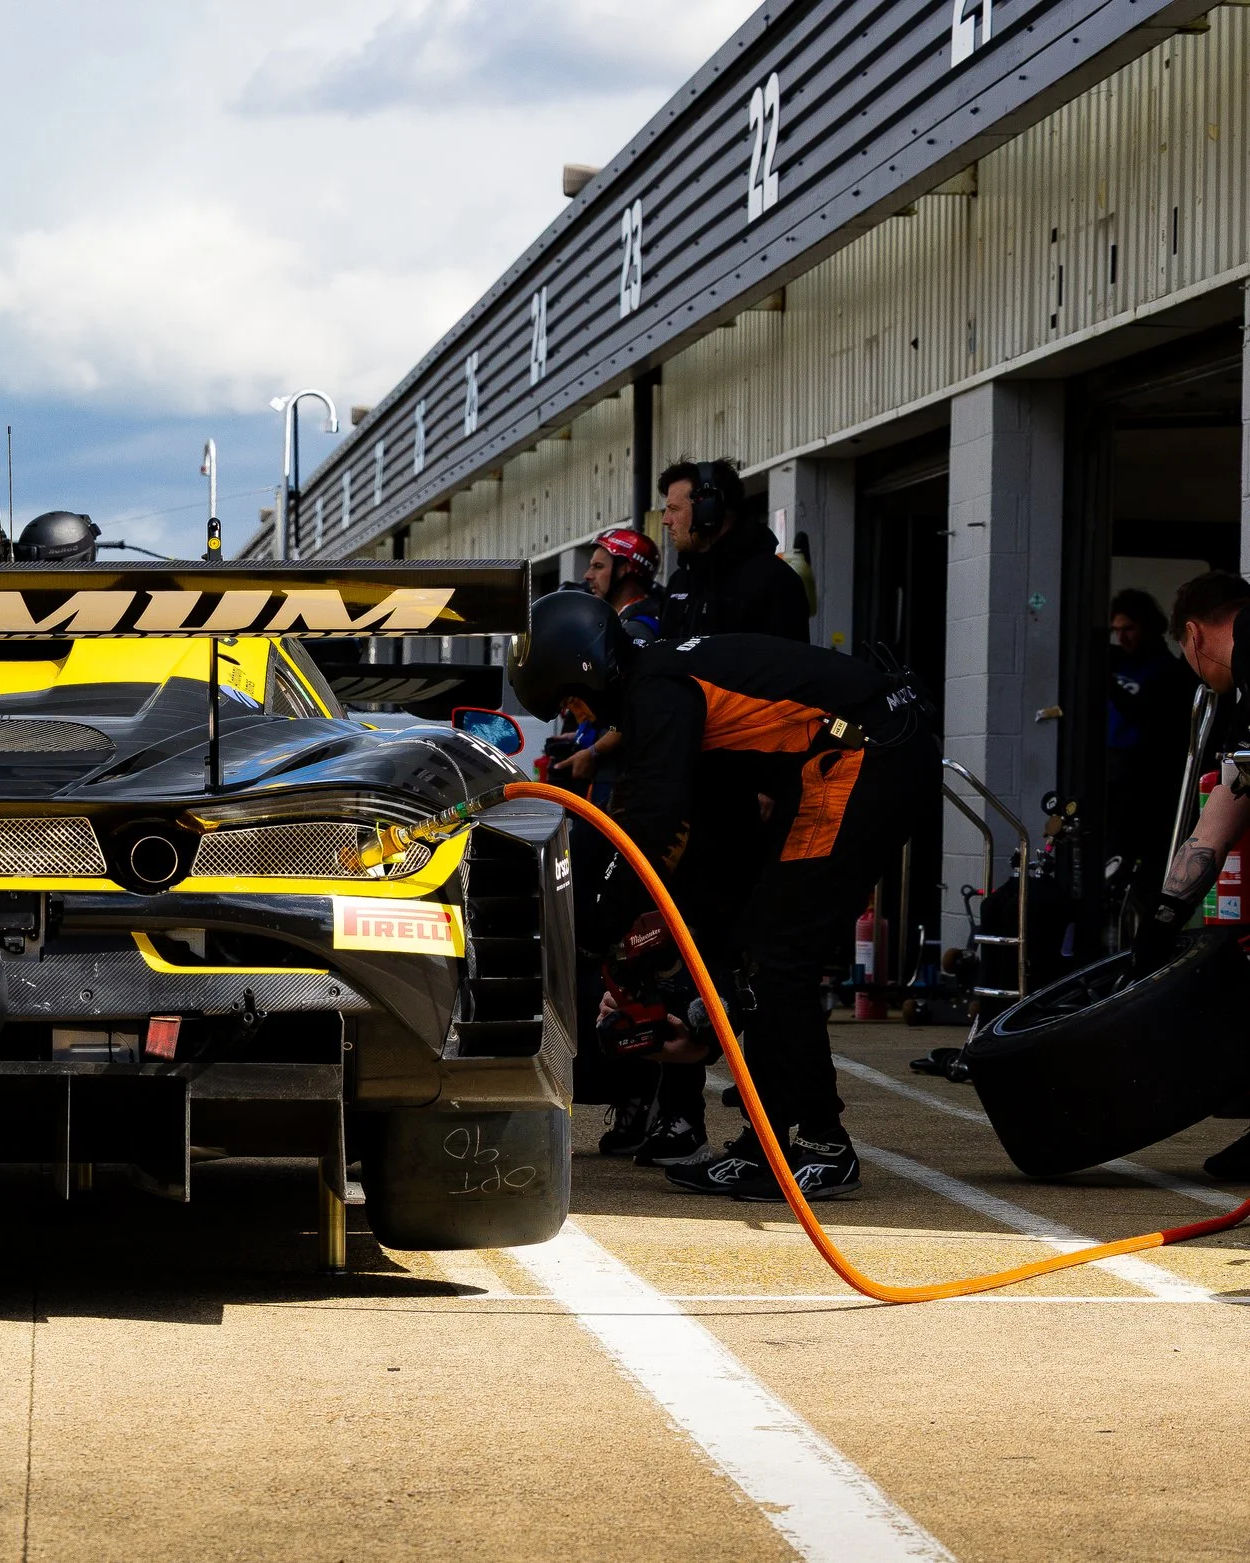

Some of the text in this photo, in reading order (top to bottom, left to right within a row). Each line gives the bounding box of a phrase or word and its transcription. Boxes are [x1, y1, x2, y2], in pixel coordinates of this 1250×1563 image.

[748, 72, 780, 224] 22
[620, 199, 643, 318] 23
[343, 906, 452, 942] PIRELLI
[449, 1164, 537, 1194] OPT
